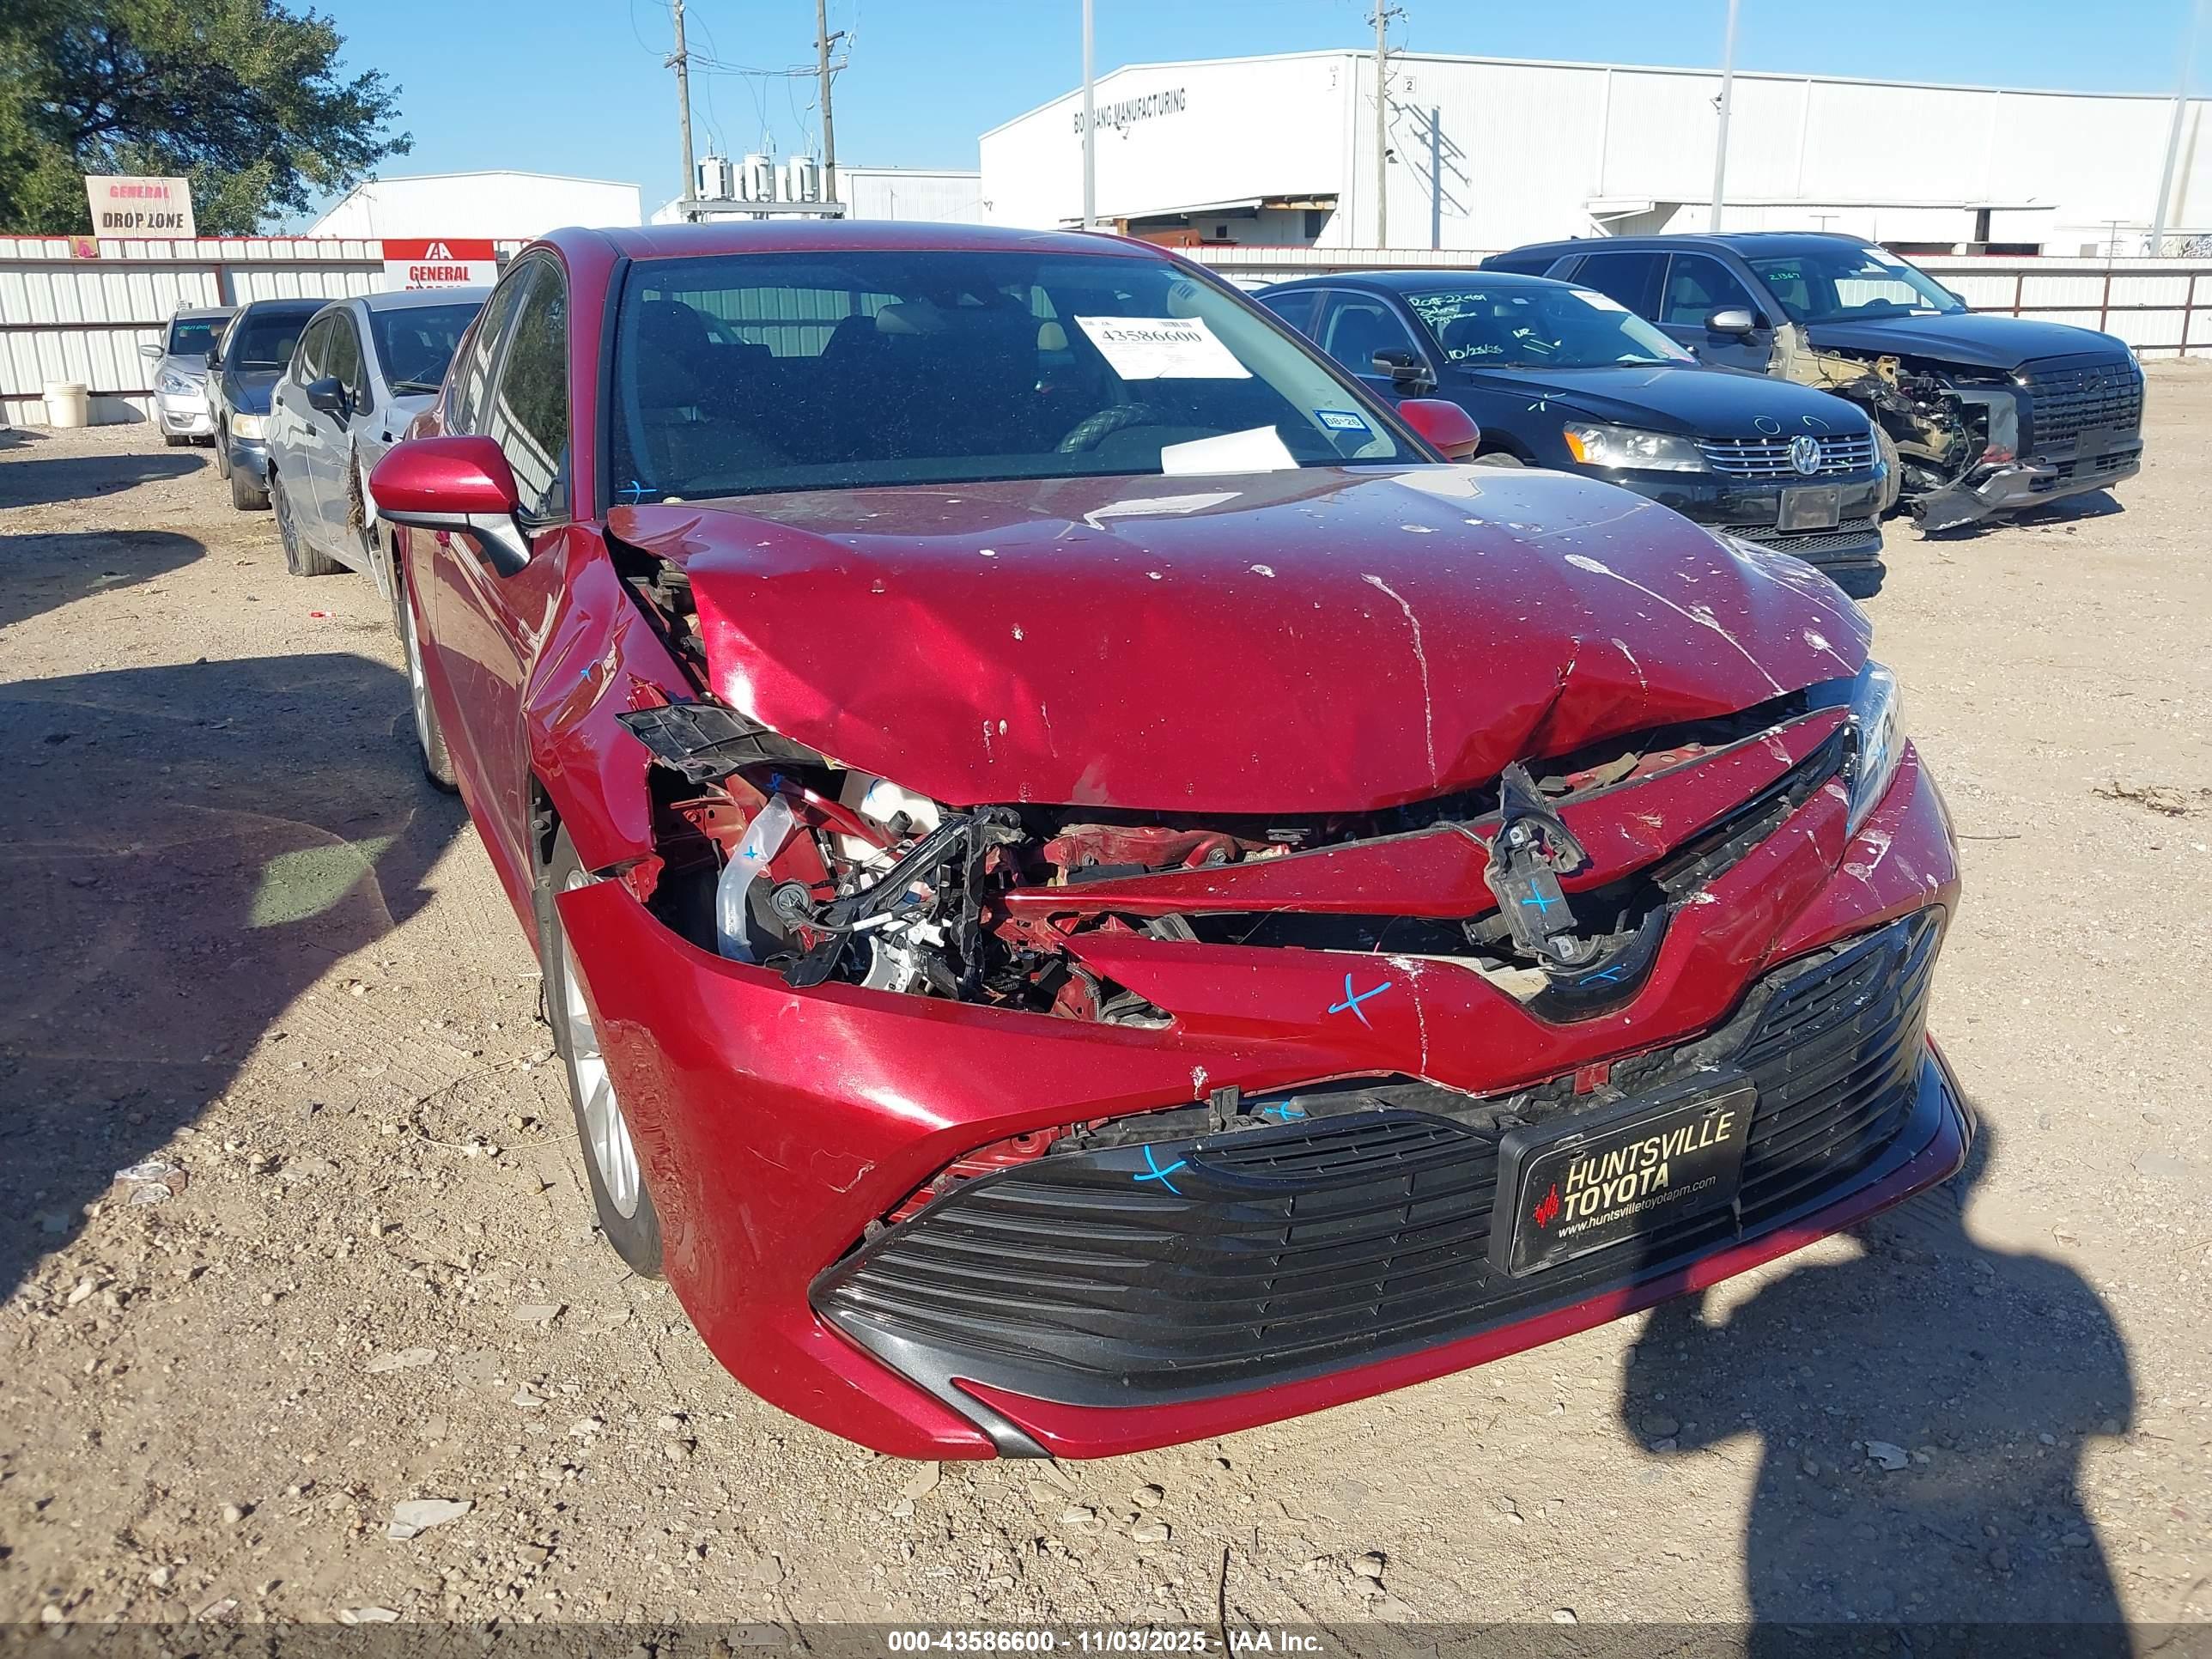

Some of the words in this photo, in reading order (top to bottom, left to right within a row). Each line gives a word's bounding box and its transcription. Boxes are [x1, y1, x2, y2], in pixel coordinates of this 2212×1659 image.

[1407, 80, 1413, 90] 2
[1114, 87, 1187, 125] MANUFACTURING
[109, 185, 170, 199] GENERAL
[102, 211, 144, 228] DROP
[147, 213, 184, 228] ZONE
[409, 265, 471, 283] GENERAL
[1102, 330, 1202, 343] 43586600
[1565, 1111, 1735, 1194] HUNTSVILLE
[1564, 1163, 1669, 1222] TOYOTA
[1558, 1175, 1717, 1239] www.huntsvilletoyotapm.com
